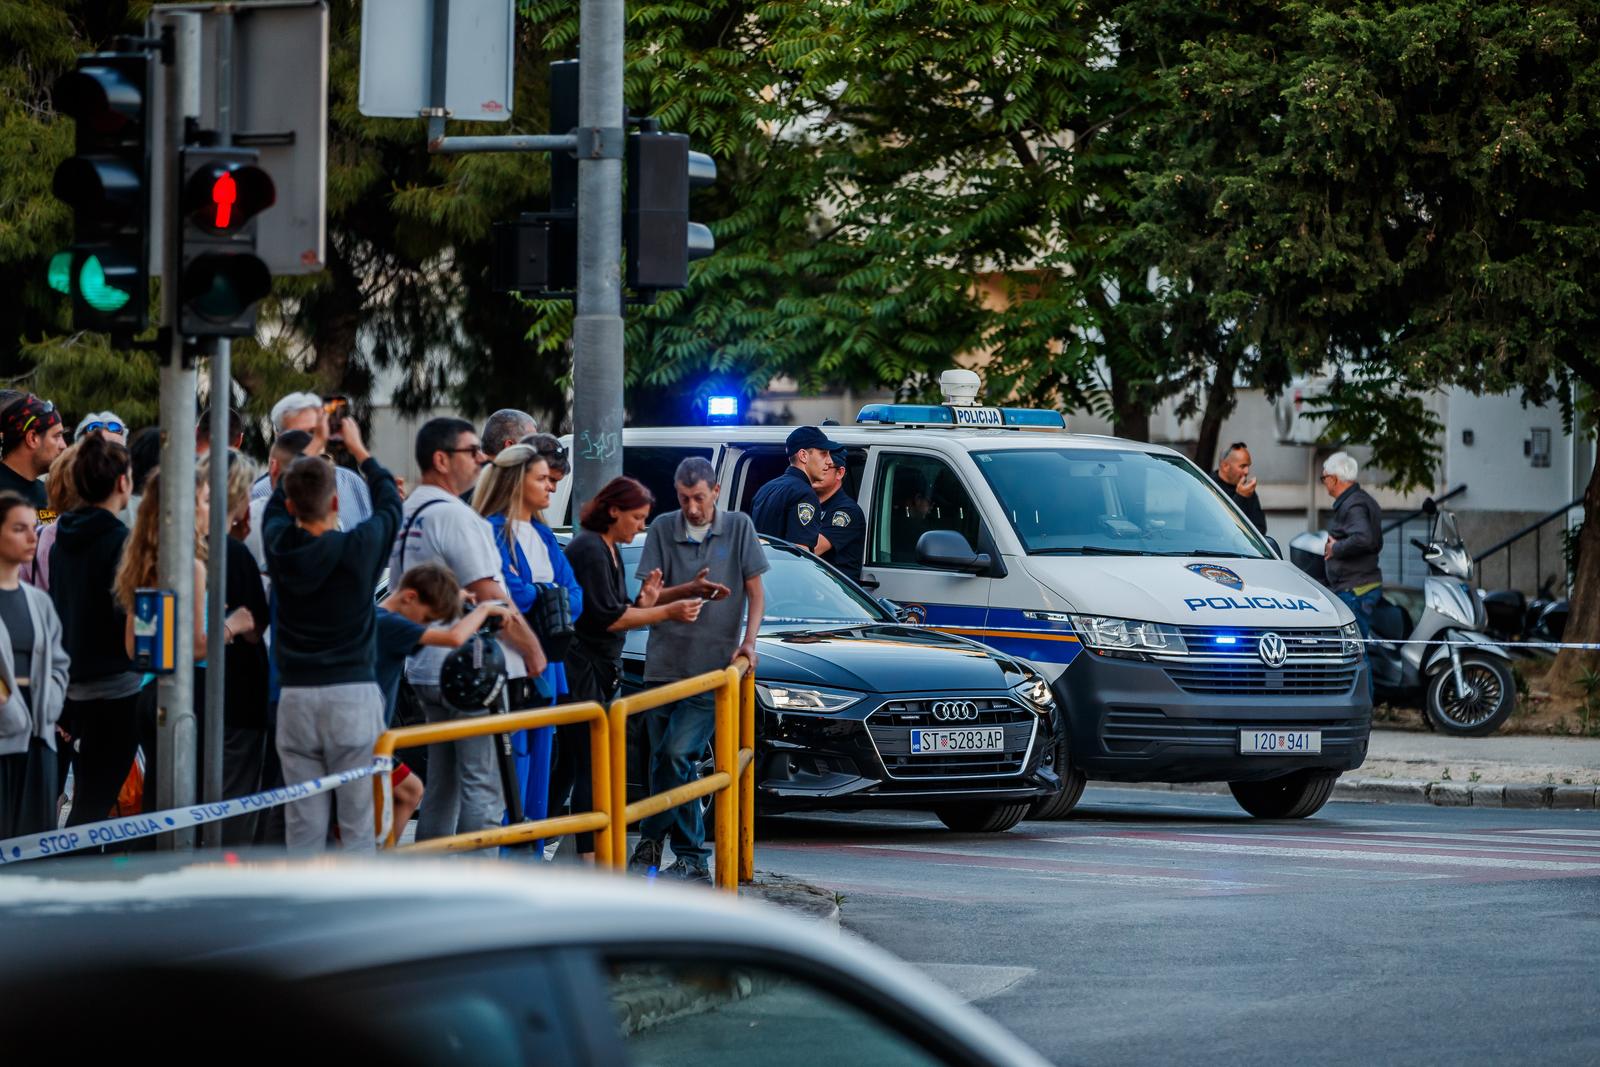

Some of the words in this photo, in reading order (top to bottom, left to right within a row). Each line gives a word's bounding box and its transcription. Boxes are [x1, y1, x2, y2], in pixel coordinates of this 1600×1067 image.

[957, 409, 1000, 424] POLICIJA
[1184, 596, 1319, 613] POLICIJA
[922, 732, 940, 751] ST
[1254, 733, 1277, 750] 120
[1287, 733, 1309, 750] 941
[39, 832, 79, 854] STOP
[88, 818, 162, 844] POLICIJA
